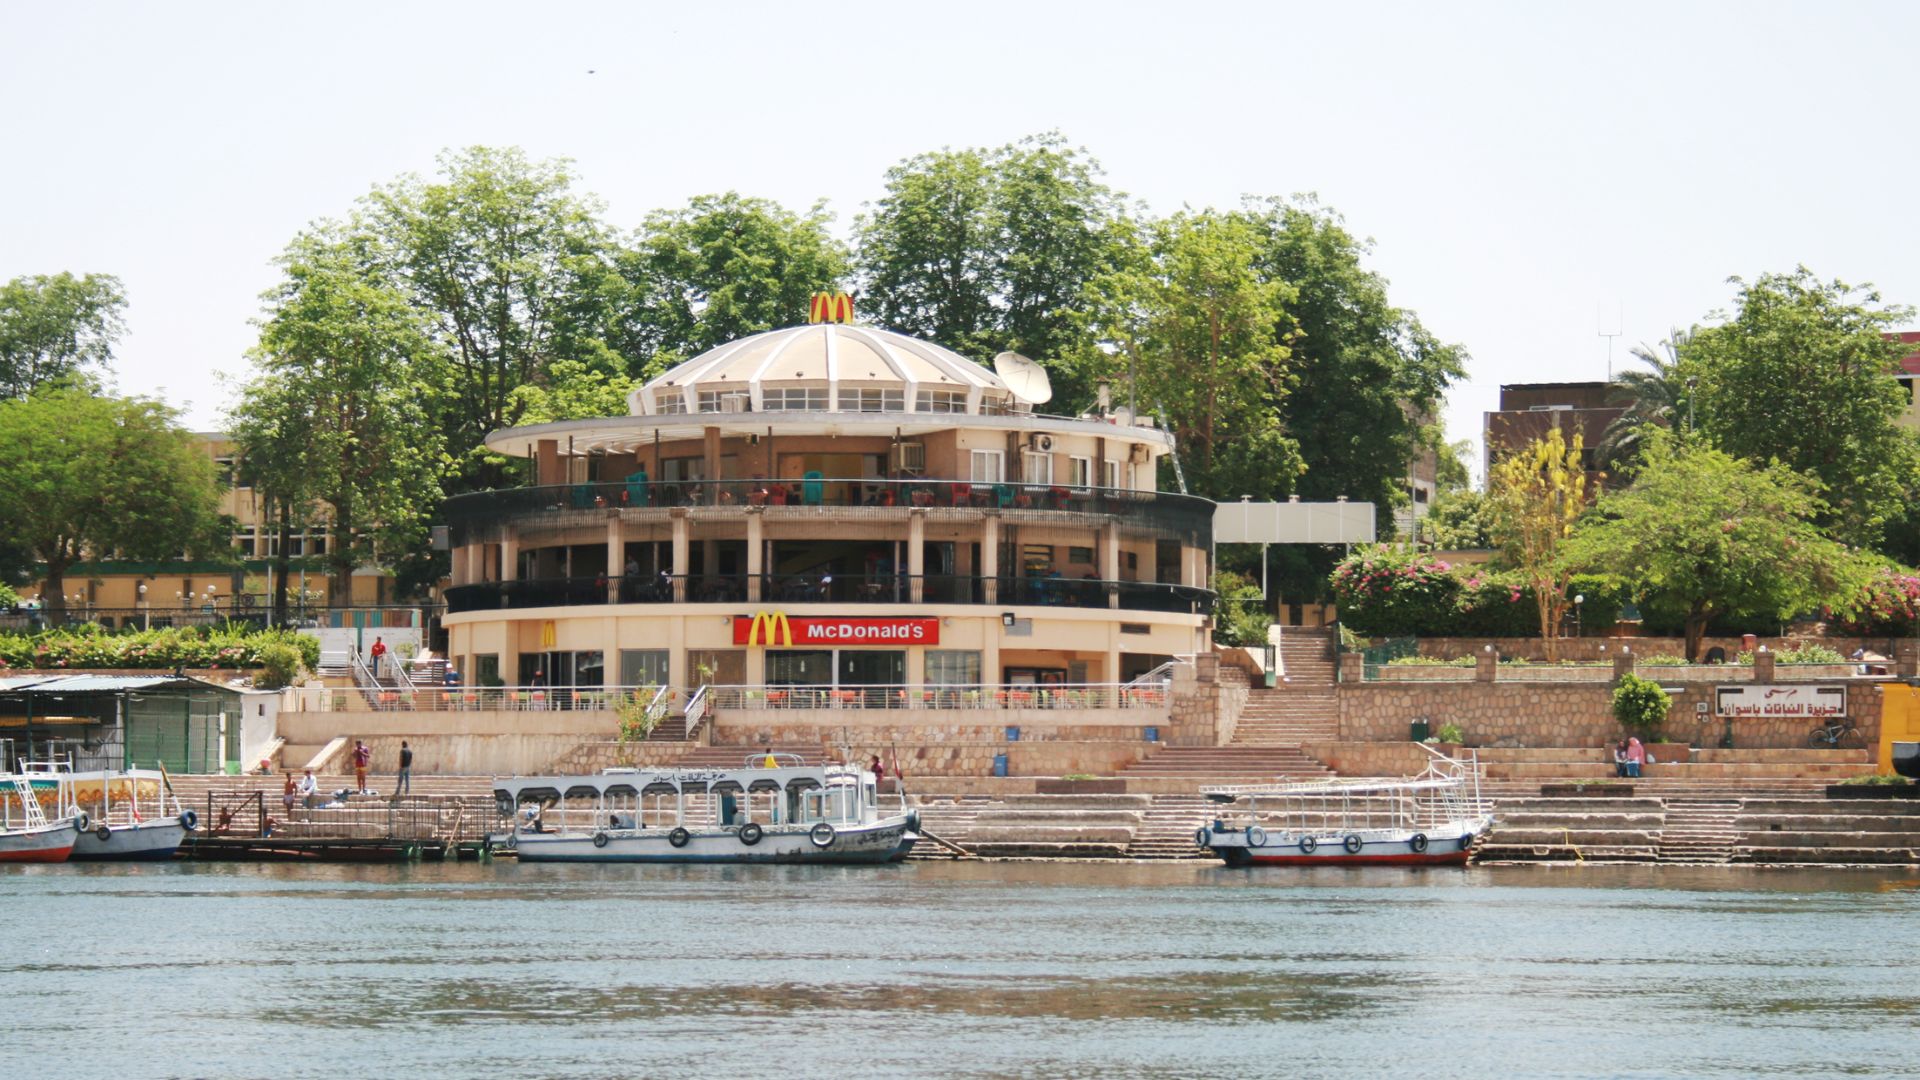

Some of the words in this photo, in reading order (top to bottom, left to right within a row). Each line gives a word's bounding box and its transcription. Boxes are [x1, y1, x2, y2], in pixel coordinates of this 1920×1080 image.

[807, 622, 923, 638] McDonald's
[1764, 703, 1804, 717] النباتات
[1807, 703, 1839, 717] جزيرة
